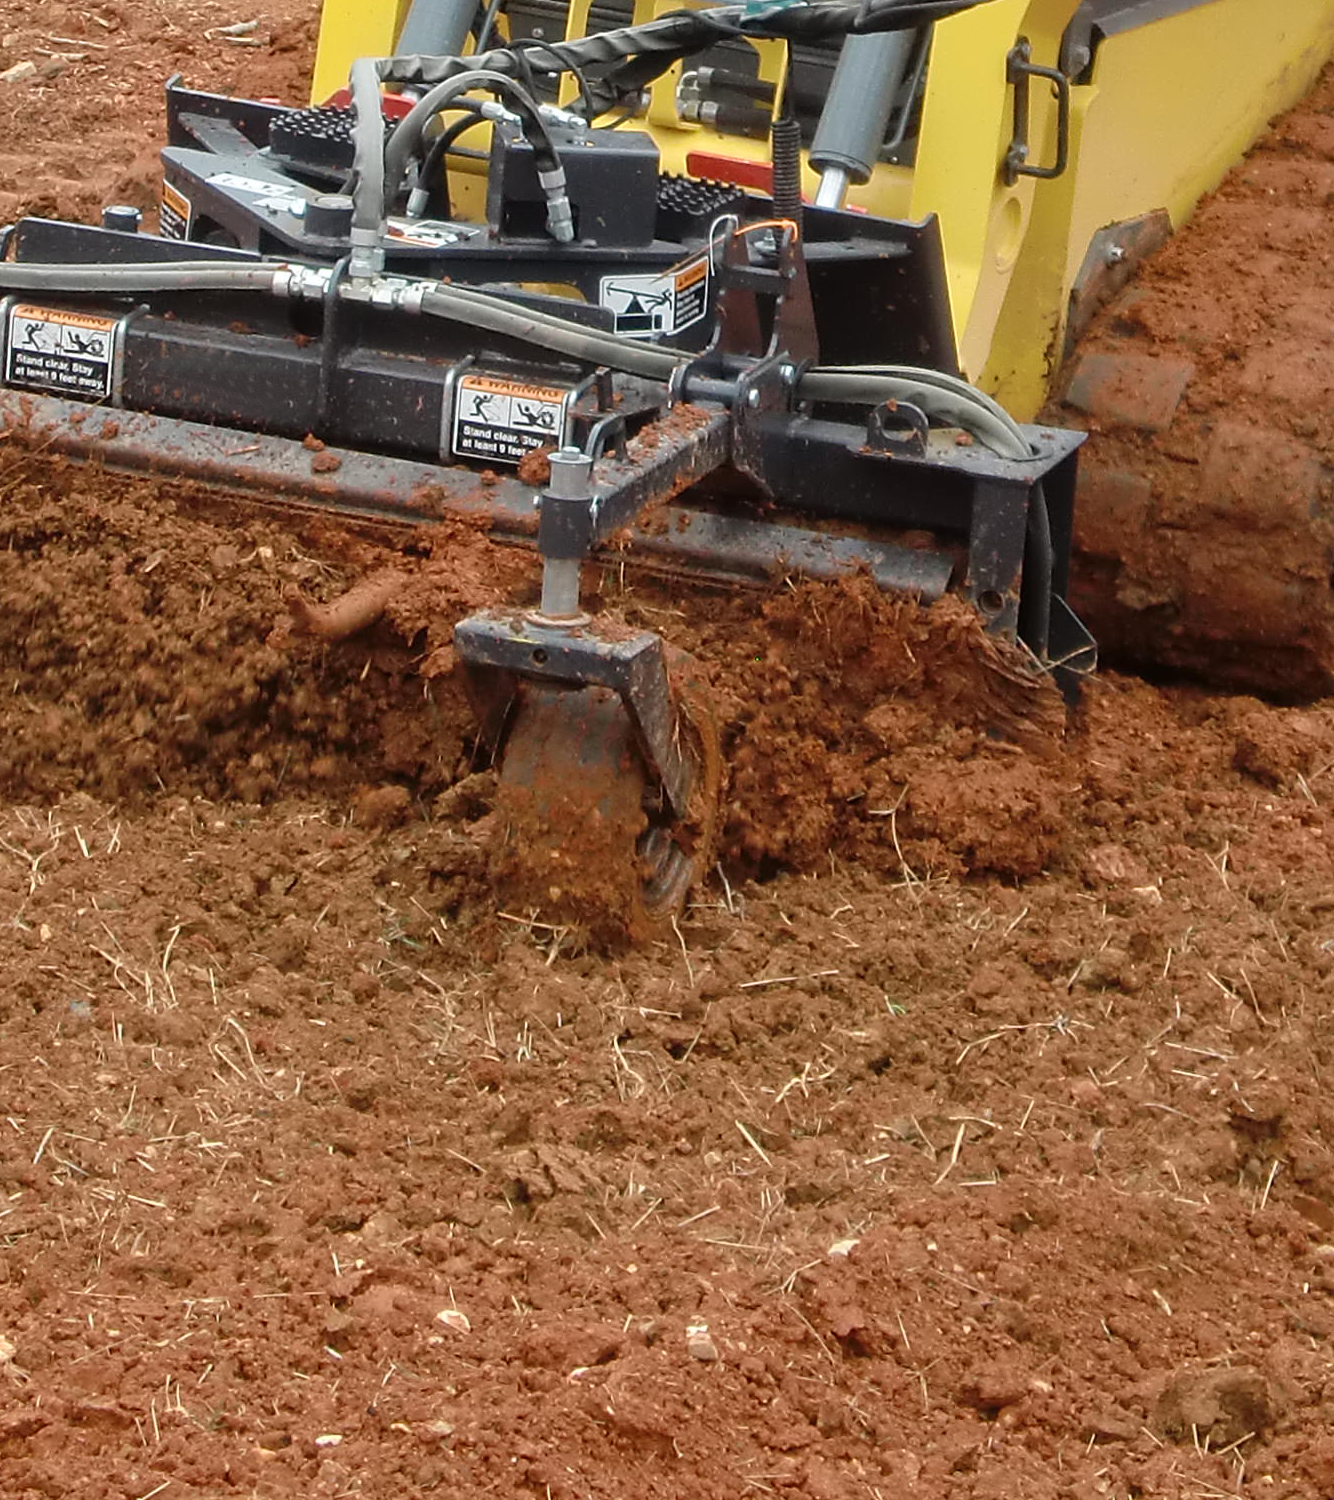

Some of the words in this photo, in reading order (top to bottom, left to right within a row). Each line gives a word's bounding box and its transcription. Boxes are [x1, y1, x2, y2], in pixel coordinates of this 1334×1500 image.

[15, 366, 25, 376] at
[16, 353, 44, 367] Stand
[72, 362, 93, 377] Stay
[462, 438, 472, 448] at
[474, 440, 498, 452] least
[463, 425, 492, 440] Stand
[521, 435, 544, 449] Stay
